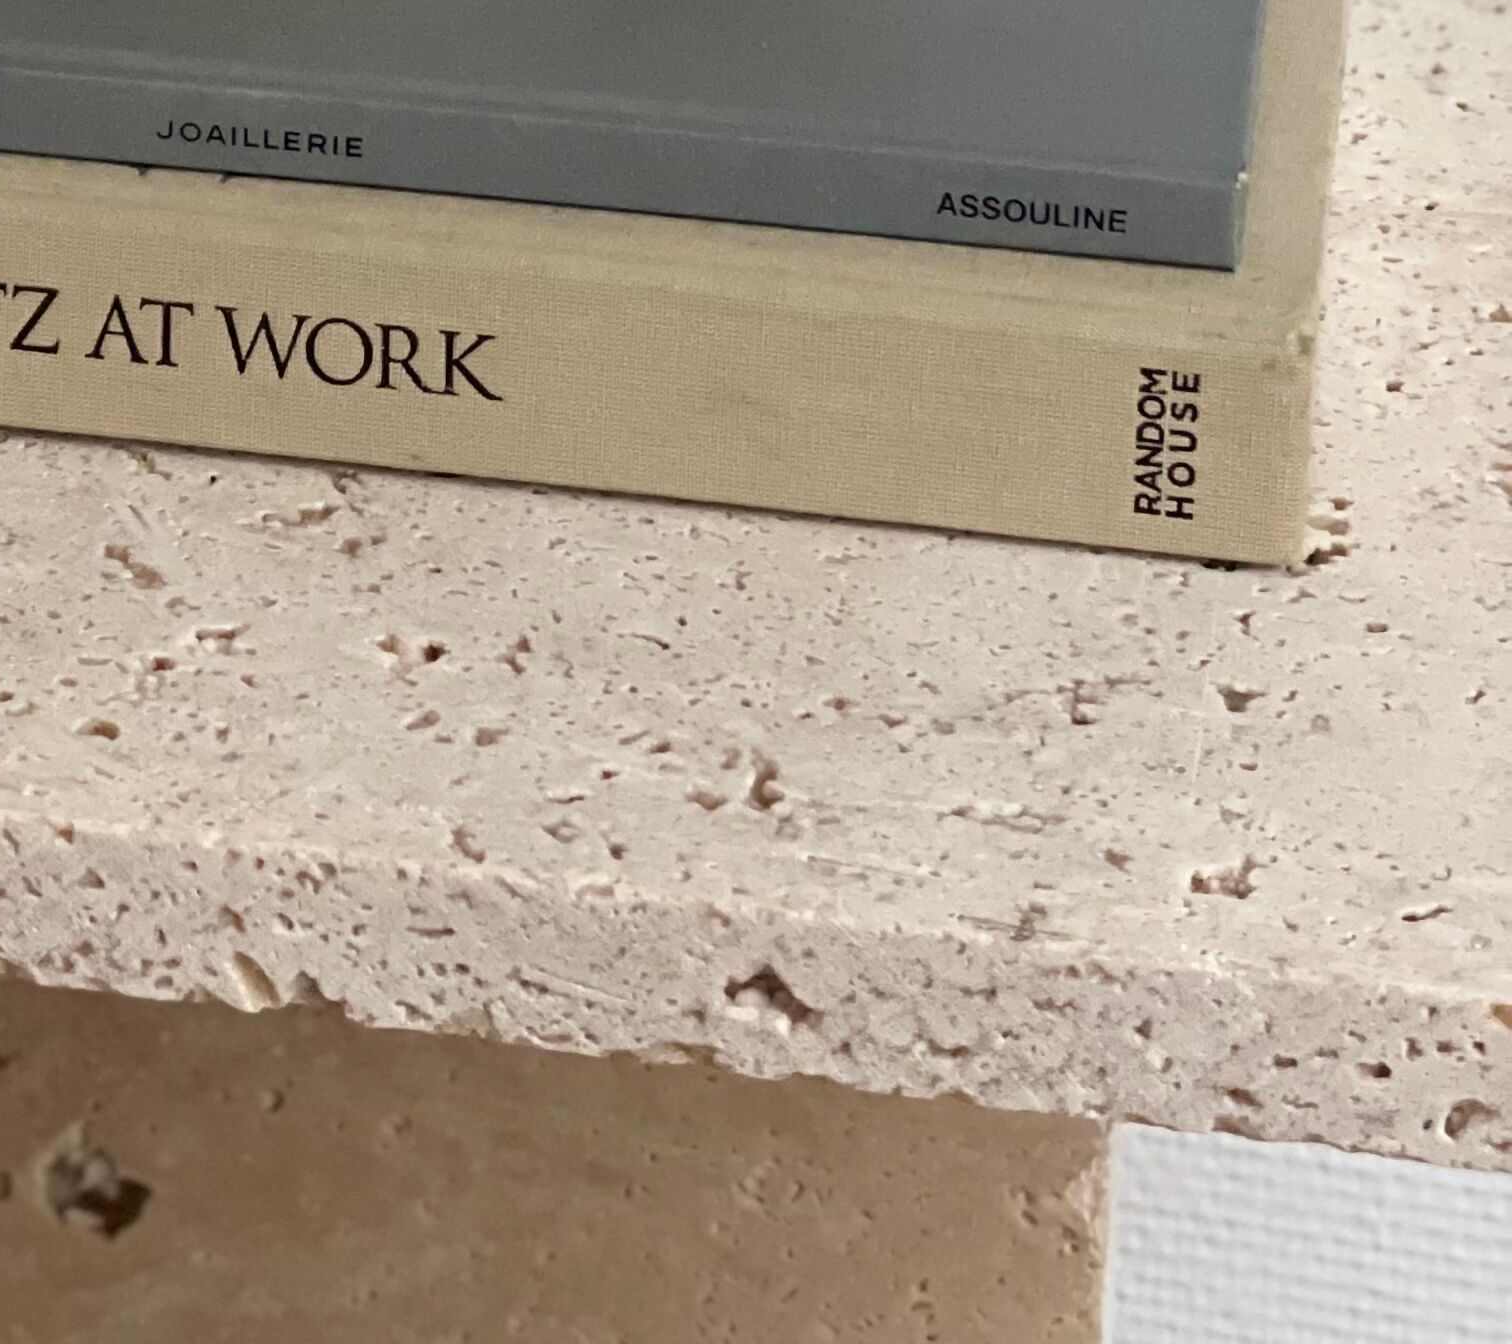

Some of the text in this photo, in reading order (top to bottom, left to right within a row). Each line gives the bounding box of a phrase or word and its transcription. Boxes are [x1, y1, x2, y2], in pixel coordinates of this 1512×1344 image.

[155, 119, 364, 158] JOAILLERIE
[936, 192, 1128, 234] ASSOULINE
[85, 294, 194, 368] AT
[214, 305, 504, 402] WORK
[1133, 367, 1169, 516] RANDOM
[1164, 372, 1202, 520] HOUSE
